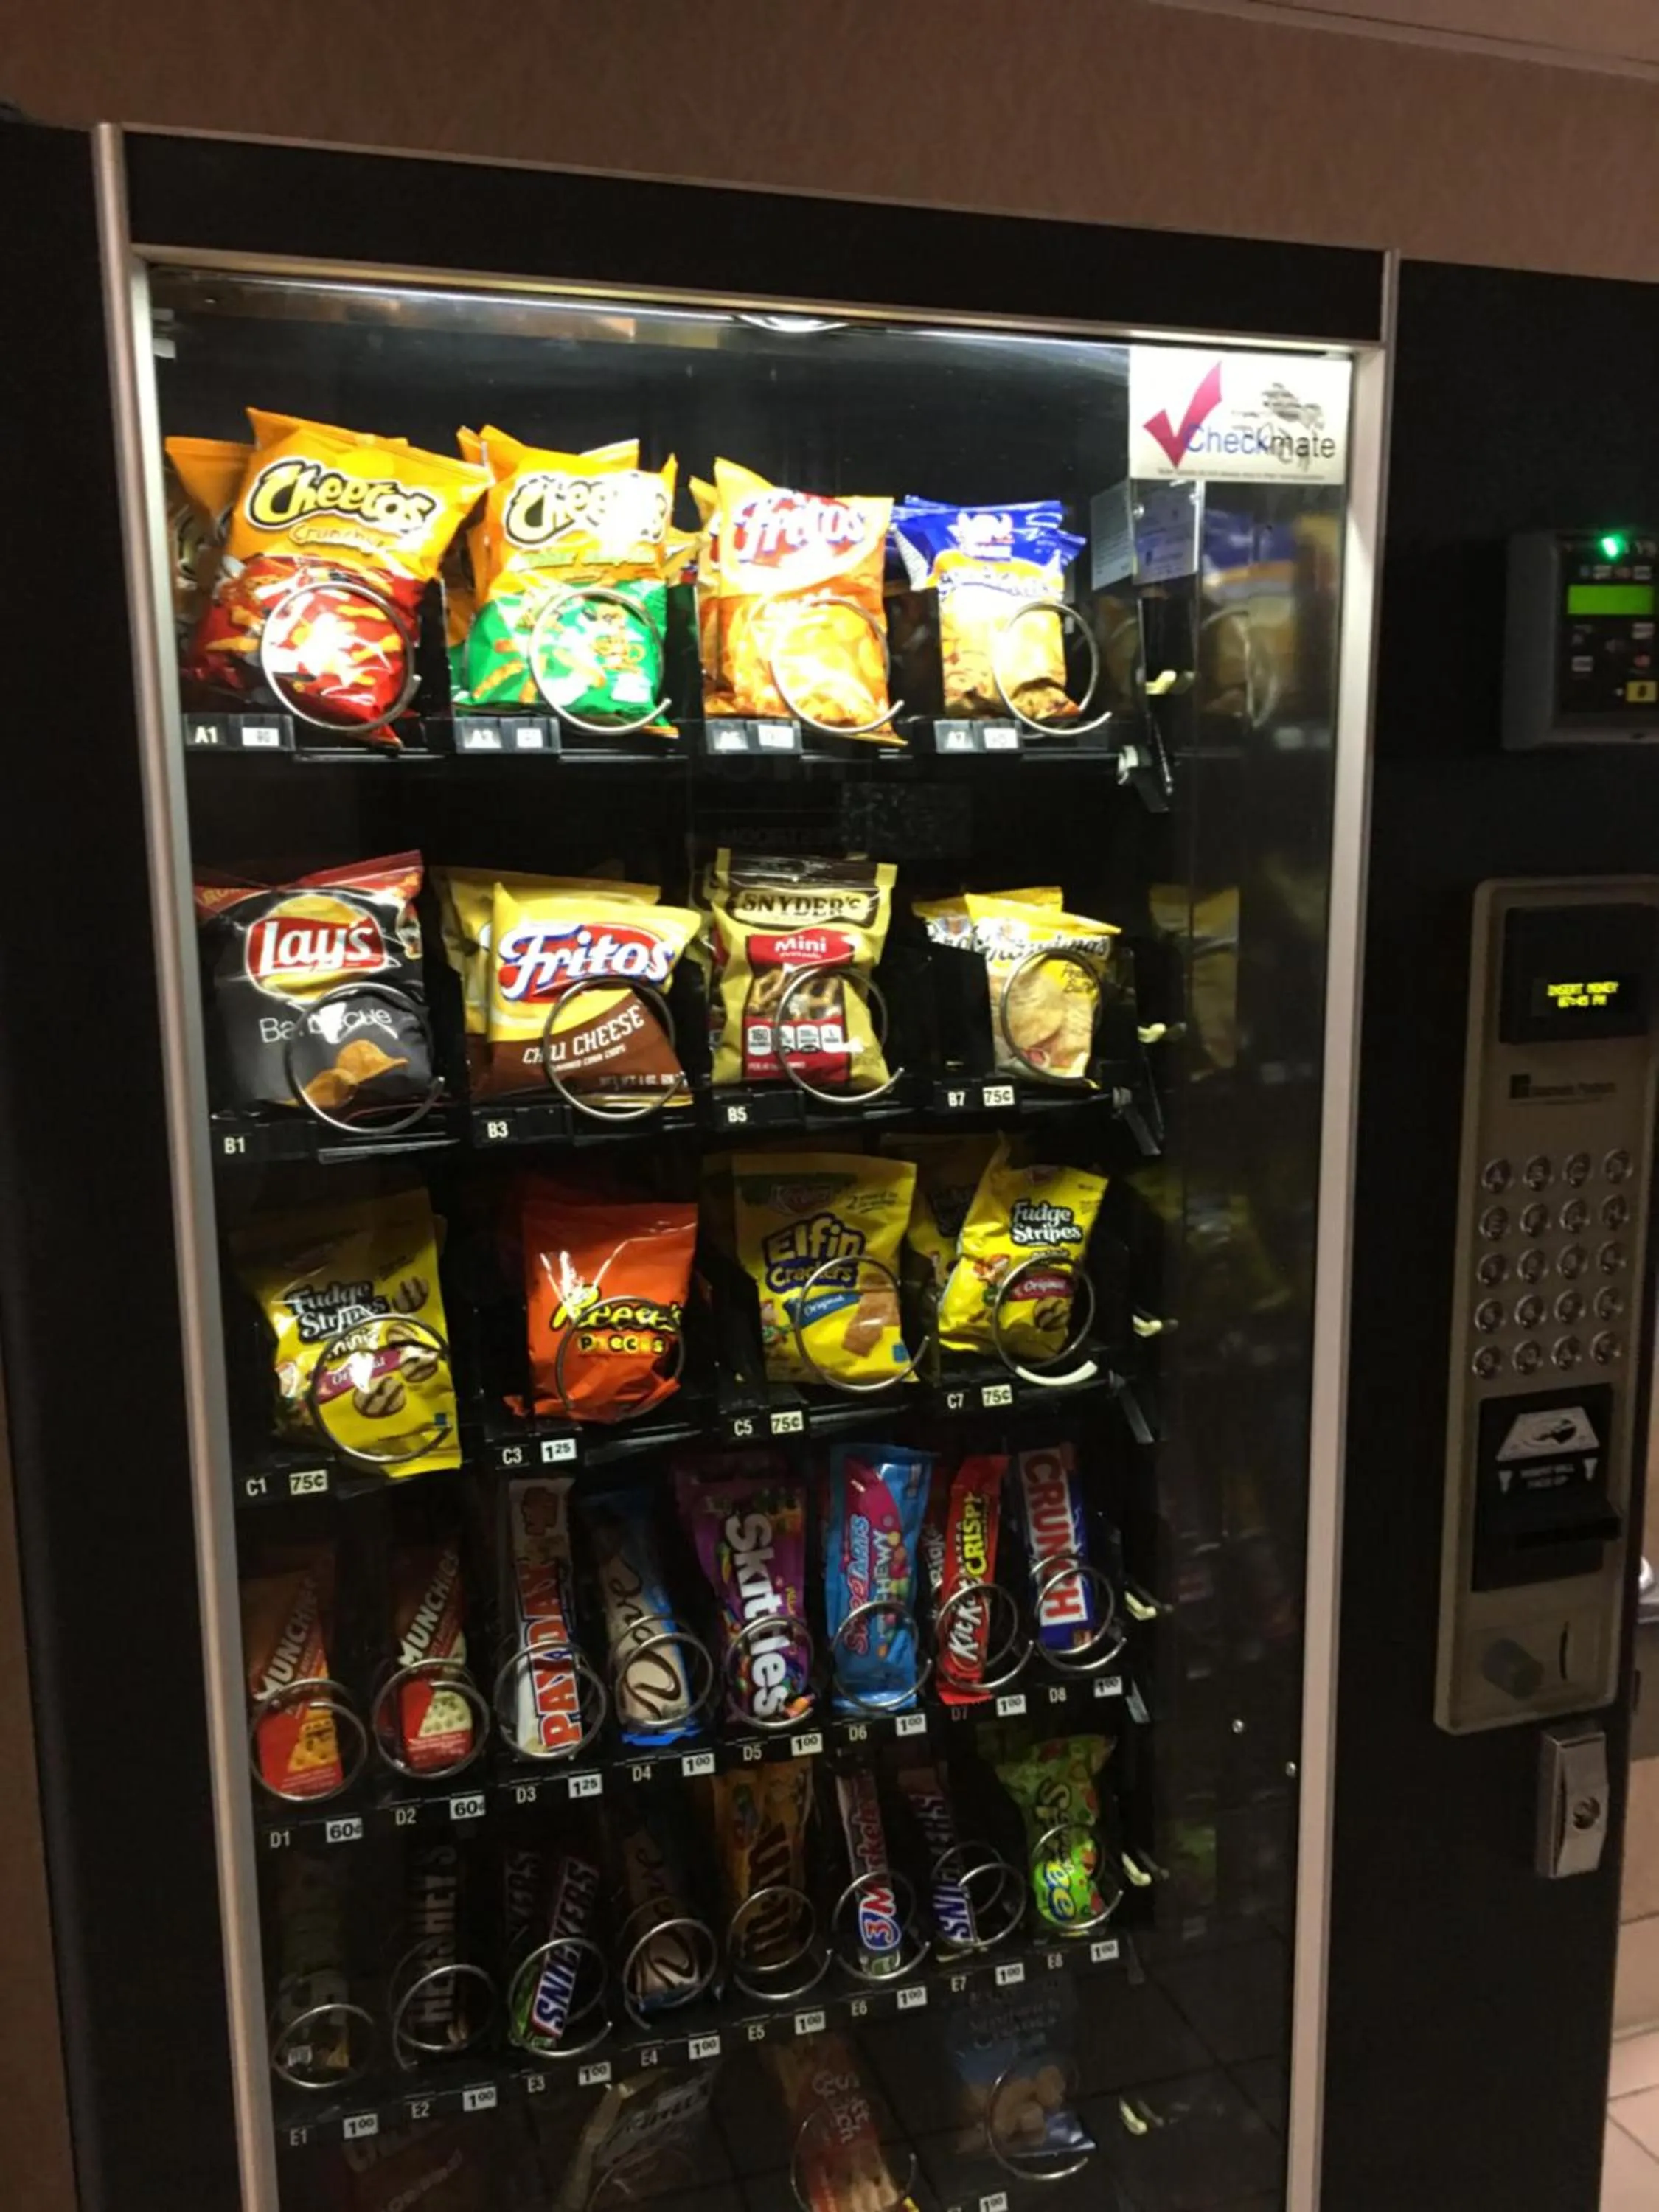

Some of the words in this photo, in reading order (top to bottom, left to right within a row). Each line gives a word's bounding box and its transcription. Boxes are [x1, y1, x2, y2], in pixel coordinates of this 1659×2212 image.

[1184, 423, 1336, 459] Checkmate
[248, 459, 437, 534] Cheetos
[195, 726, 218, 743] A1
[258, 920, 374, 976] Lay's
[774, 935, 827, 953] Mini
[498, 923, 675, 1002] Fritos
[522, 1041, 567, 1065] CHLI
[572, 1004, 646, 1056] CHEESE
[947, 1091, 966, 1107] B7
[727, 1107, 748, 1123] B5
[487, 1121, 509, 1138] B3
[224, 1137, 246, 1153] B1
[1012, 1201, 1071, 1227] Fudge
[765, 1215, 861, 1262] Elfin
[1012, 1224, 1082, 1244] Stripes
[293, 1283, 369, 1314] Fudge
[947, 1393, 964, 1409] C7
[734, 1419, 753, 1436] C5
[502, 1448, 522, 1465] C3
[246, 1477, 267, 1496] C1
[963, 1490, 987, 1577] CRISPY
[1048, 1688, 1068, 1703] D8
[849, 1726, 868, 1742] D6
[742, 1744, 763, 1761] D5
[632, 1764, 653, 1783] D4
[515, 1786, 538, 1805] D3
[394, 1808, 417, 1826] D2
[270, 1830, 291, 1849] D1
[951, 1975, 967, 1992] E7
[851, 2001, 868, 2017] E6
[748, 2025, 766, 2041] E5
[641, 2050, 658, 2066] E4
[411, 2101, 431, 2119] E2
[290, 2128, 307, 2146] E1
